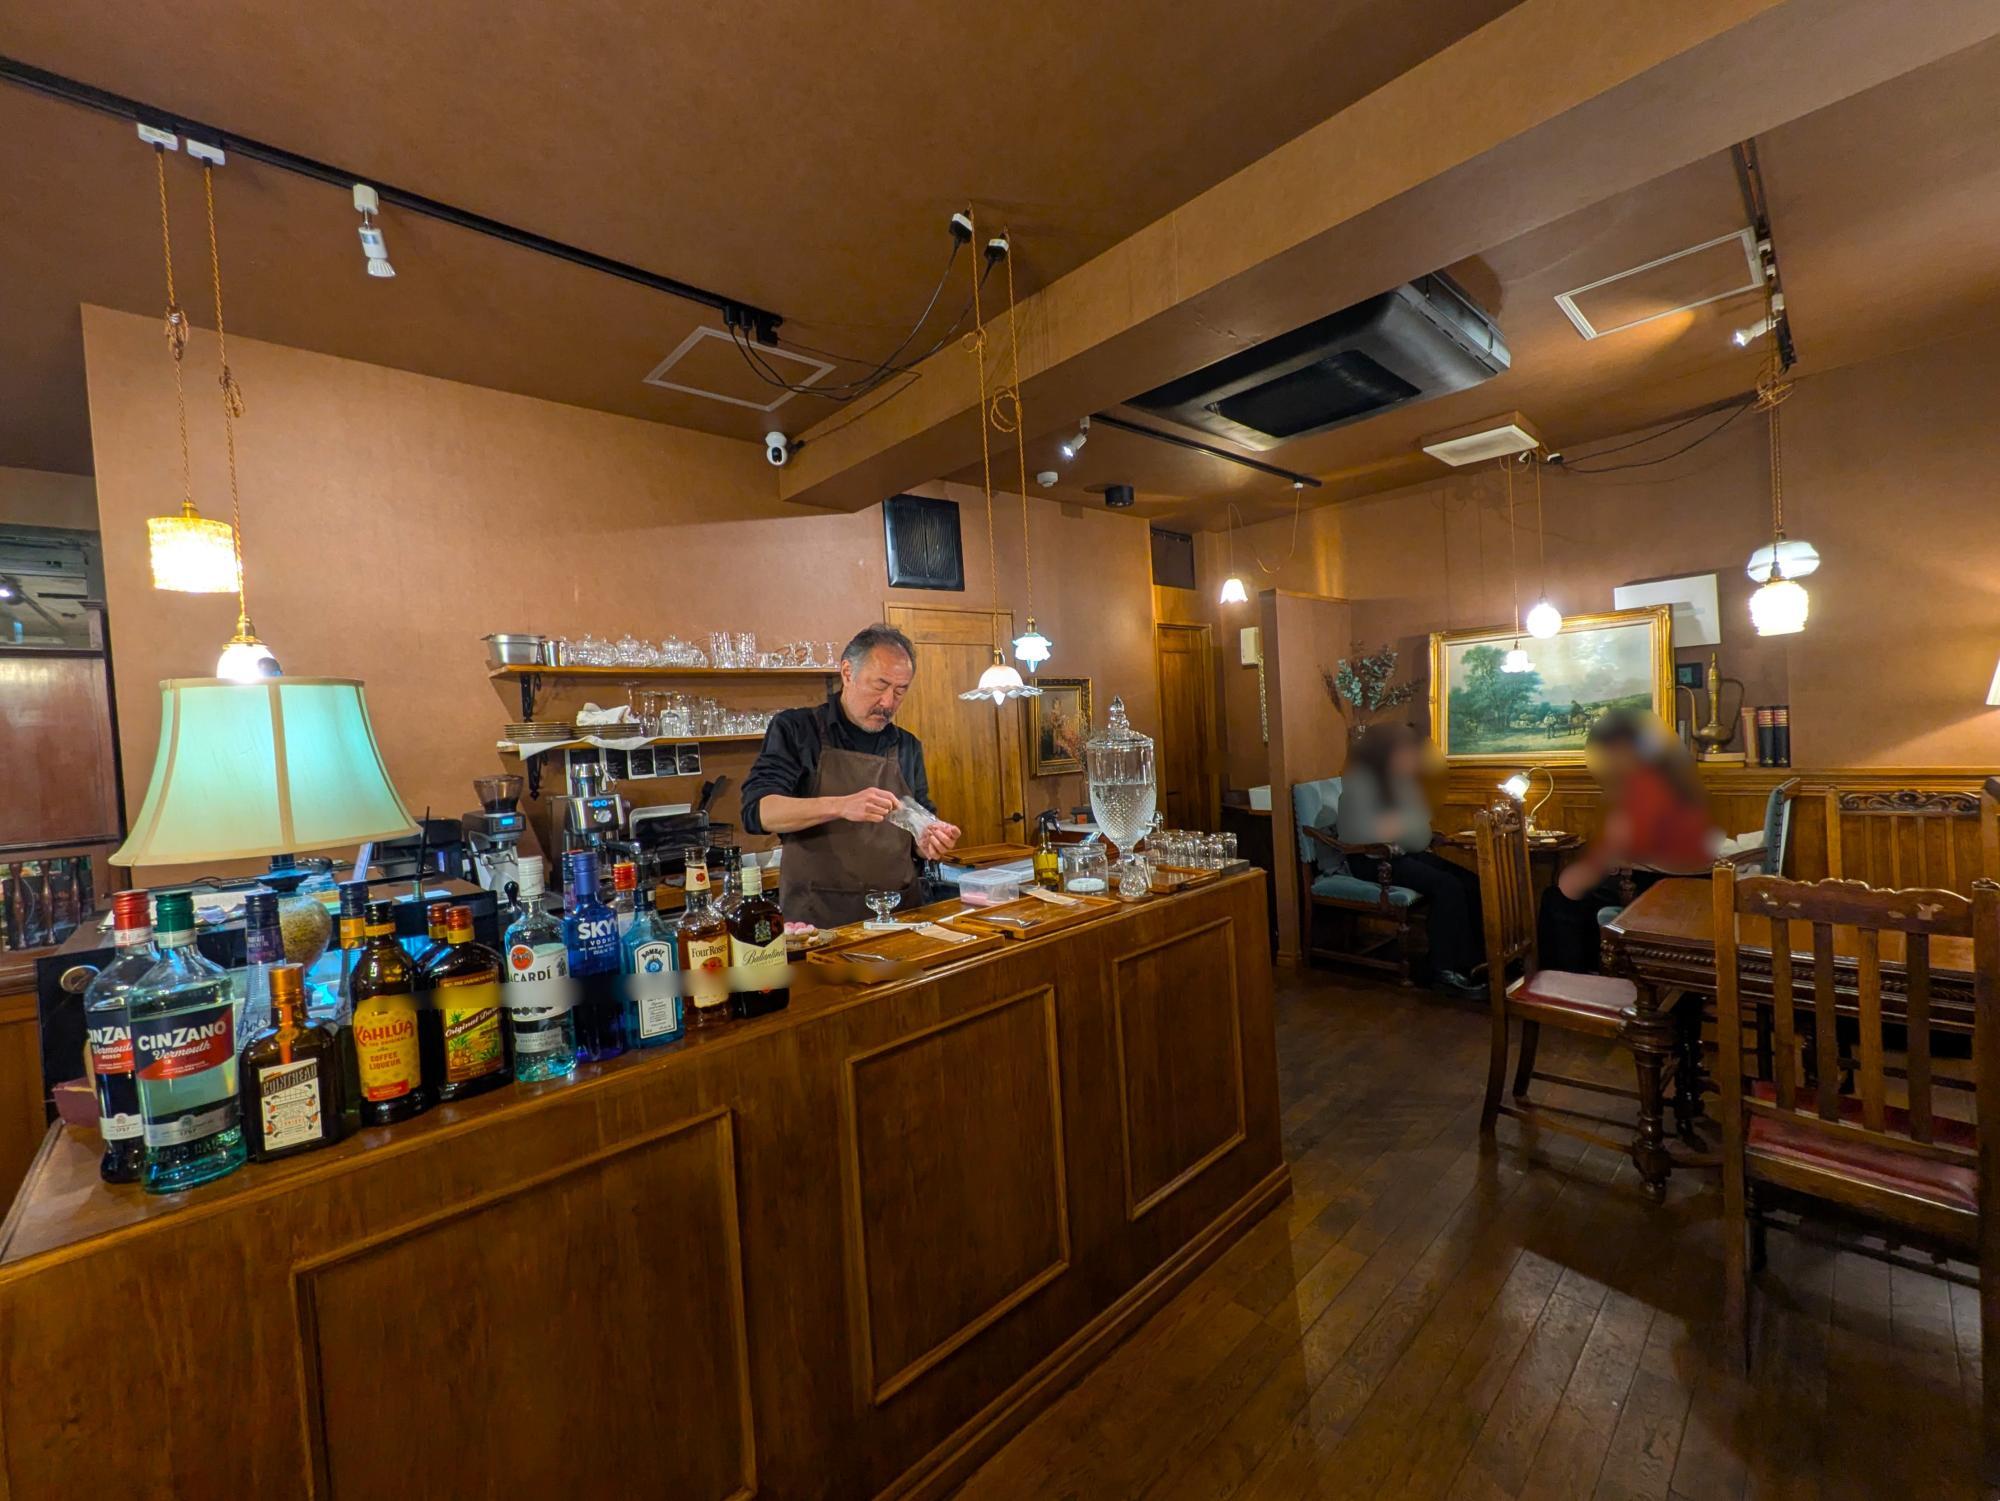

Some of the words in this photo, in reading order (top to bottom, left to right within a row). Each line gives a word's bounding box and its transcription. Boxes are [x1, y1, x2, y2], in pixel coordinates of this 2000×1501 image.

[578, 918, 617, 940] SKYY
[641, 947, 665, 960] BOMBAY
[691, 947, 708, 958] Four
[138, 1020, 226, 1051] CINZANO
[356, 1019, 415, 1047] KAHLÚA
[445, 1016, 479, 1037] Original
[152, 1041, 212, 1061] Vermouth
[370, 1051, 398, 1062] COFFEE
[369, 1058, 402, 1070] LIQUEUR
[263, 1063, 318, 1095] COINTREAU
